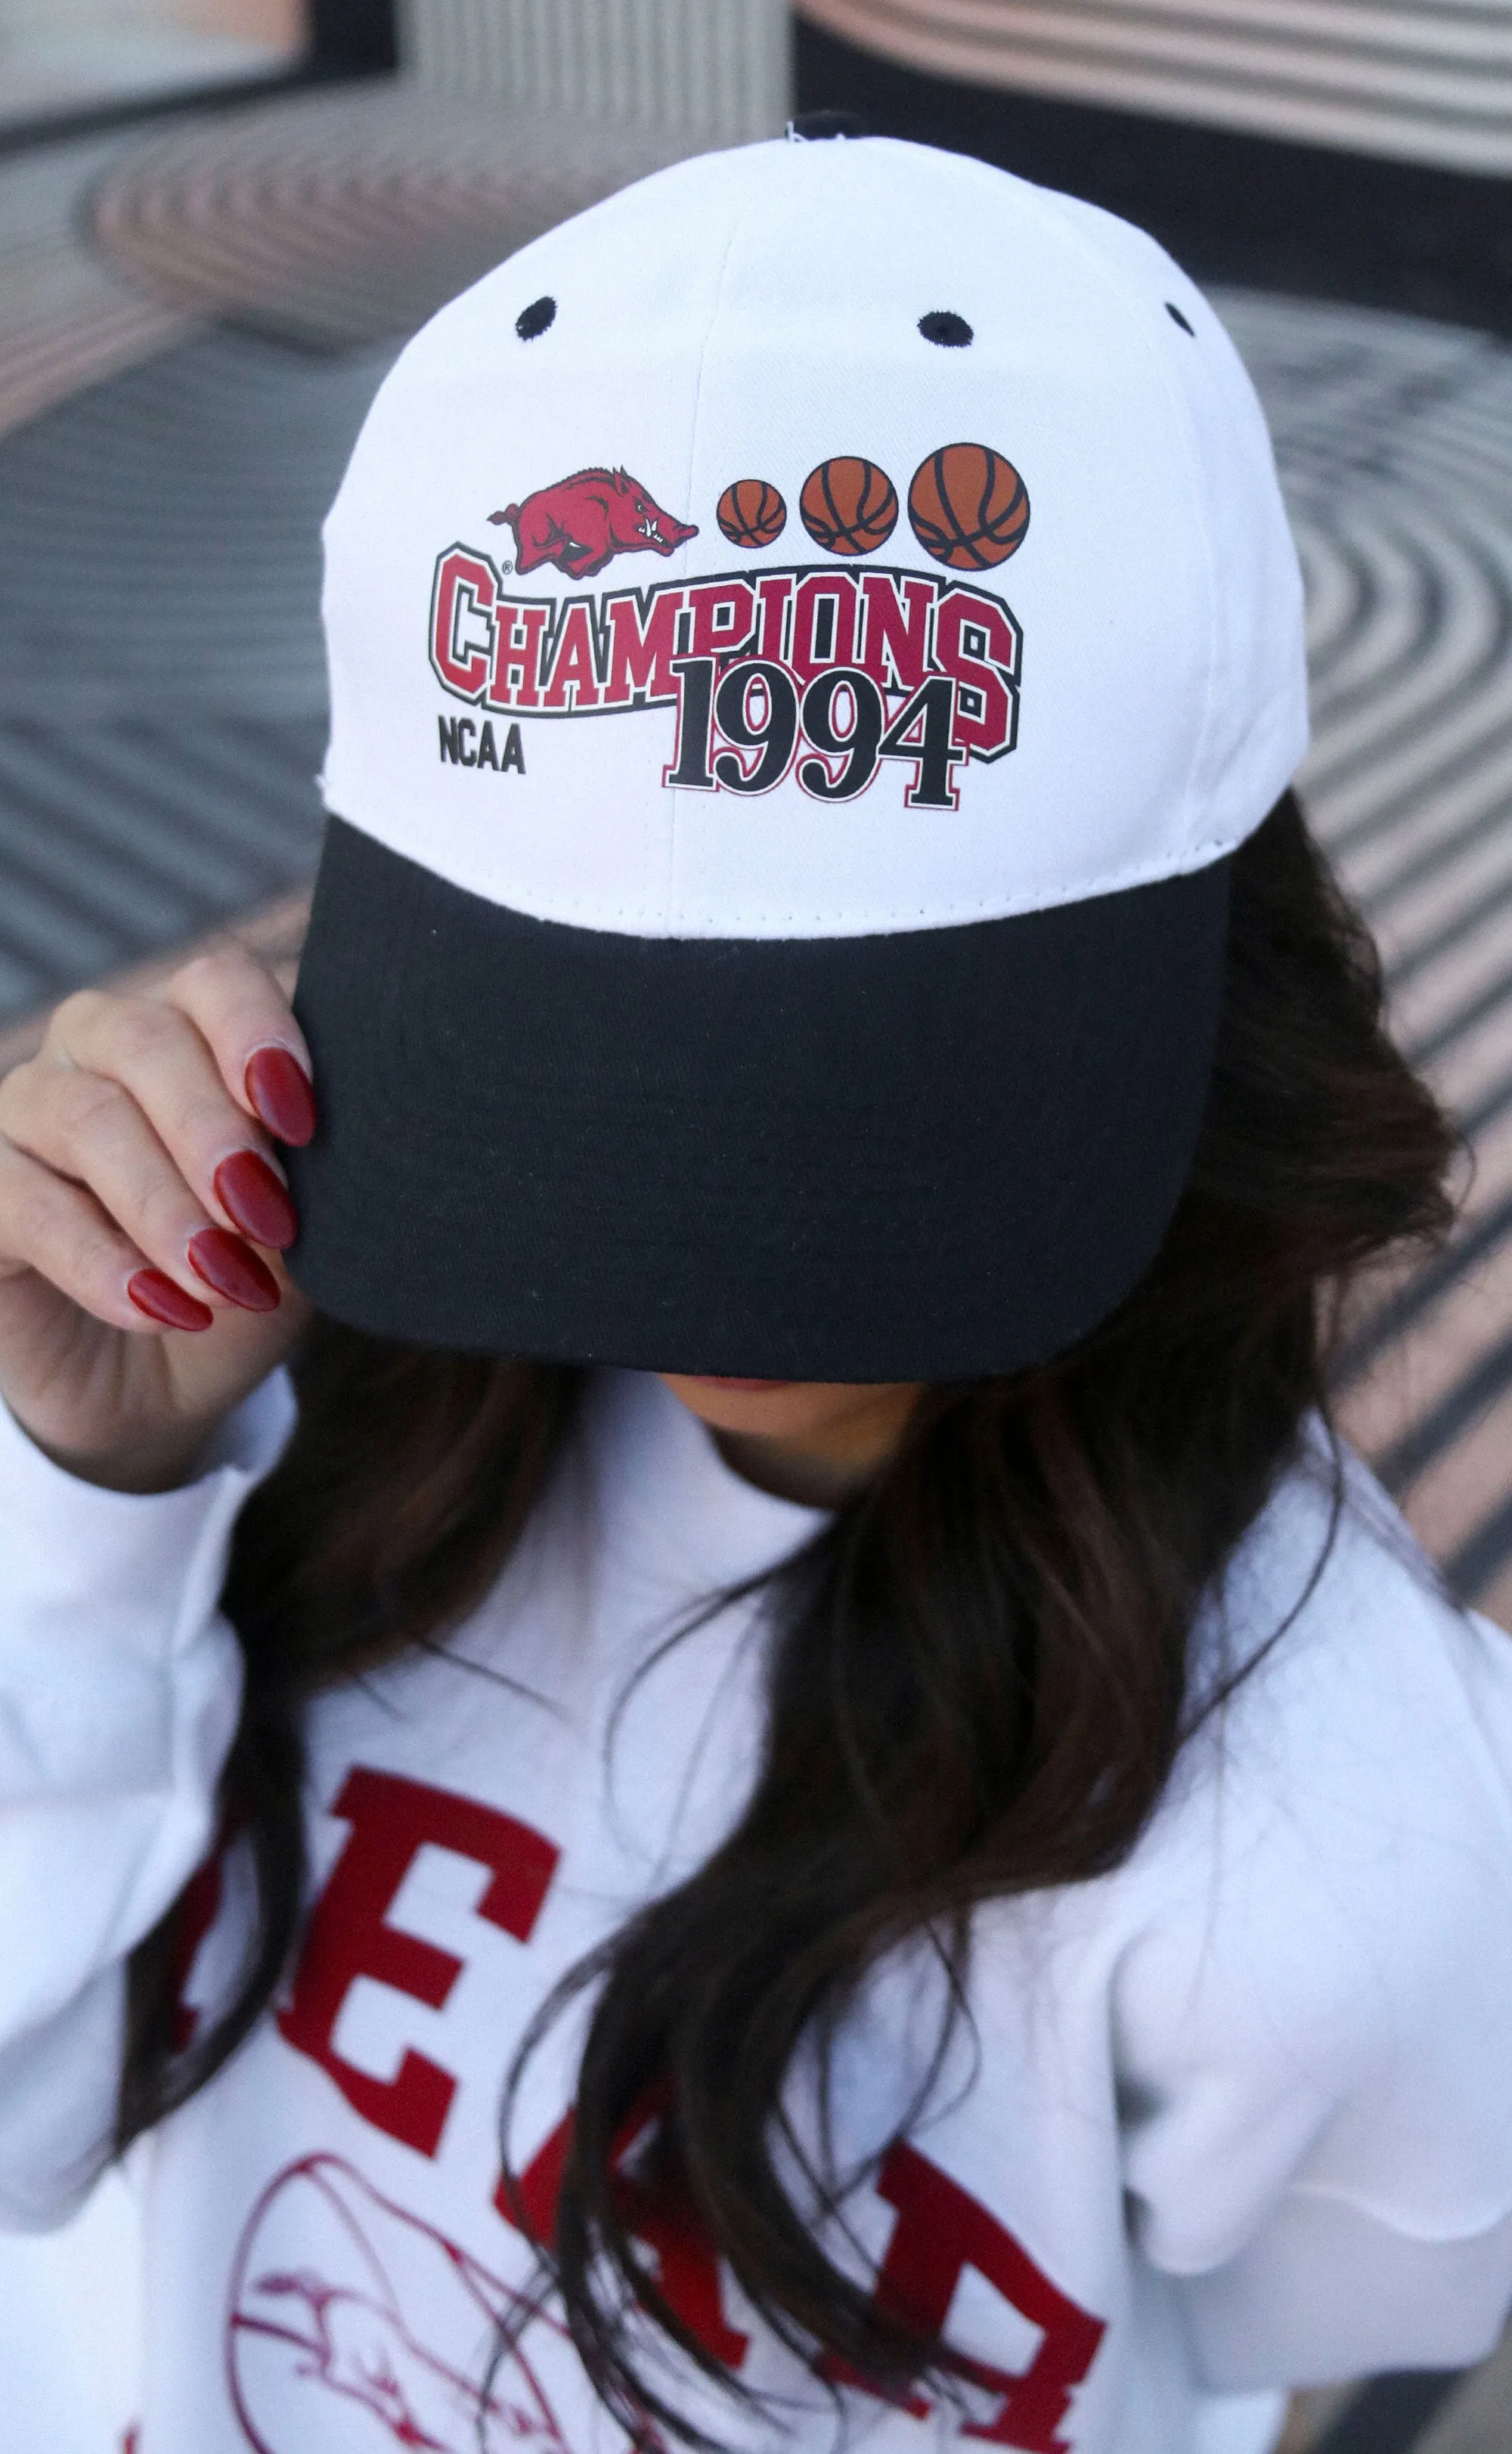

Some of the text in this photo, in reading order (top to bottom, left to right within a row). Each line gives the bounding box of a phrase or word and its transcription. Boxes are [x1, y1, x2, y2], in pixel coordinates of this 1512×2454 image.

[429, 543, 1024, 764] CHAMPIONS
[662, 653, 968, 812] 1994
[438, 715, 526, 775] NCAA
